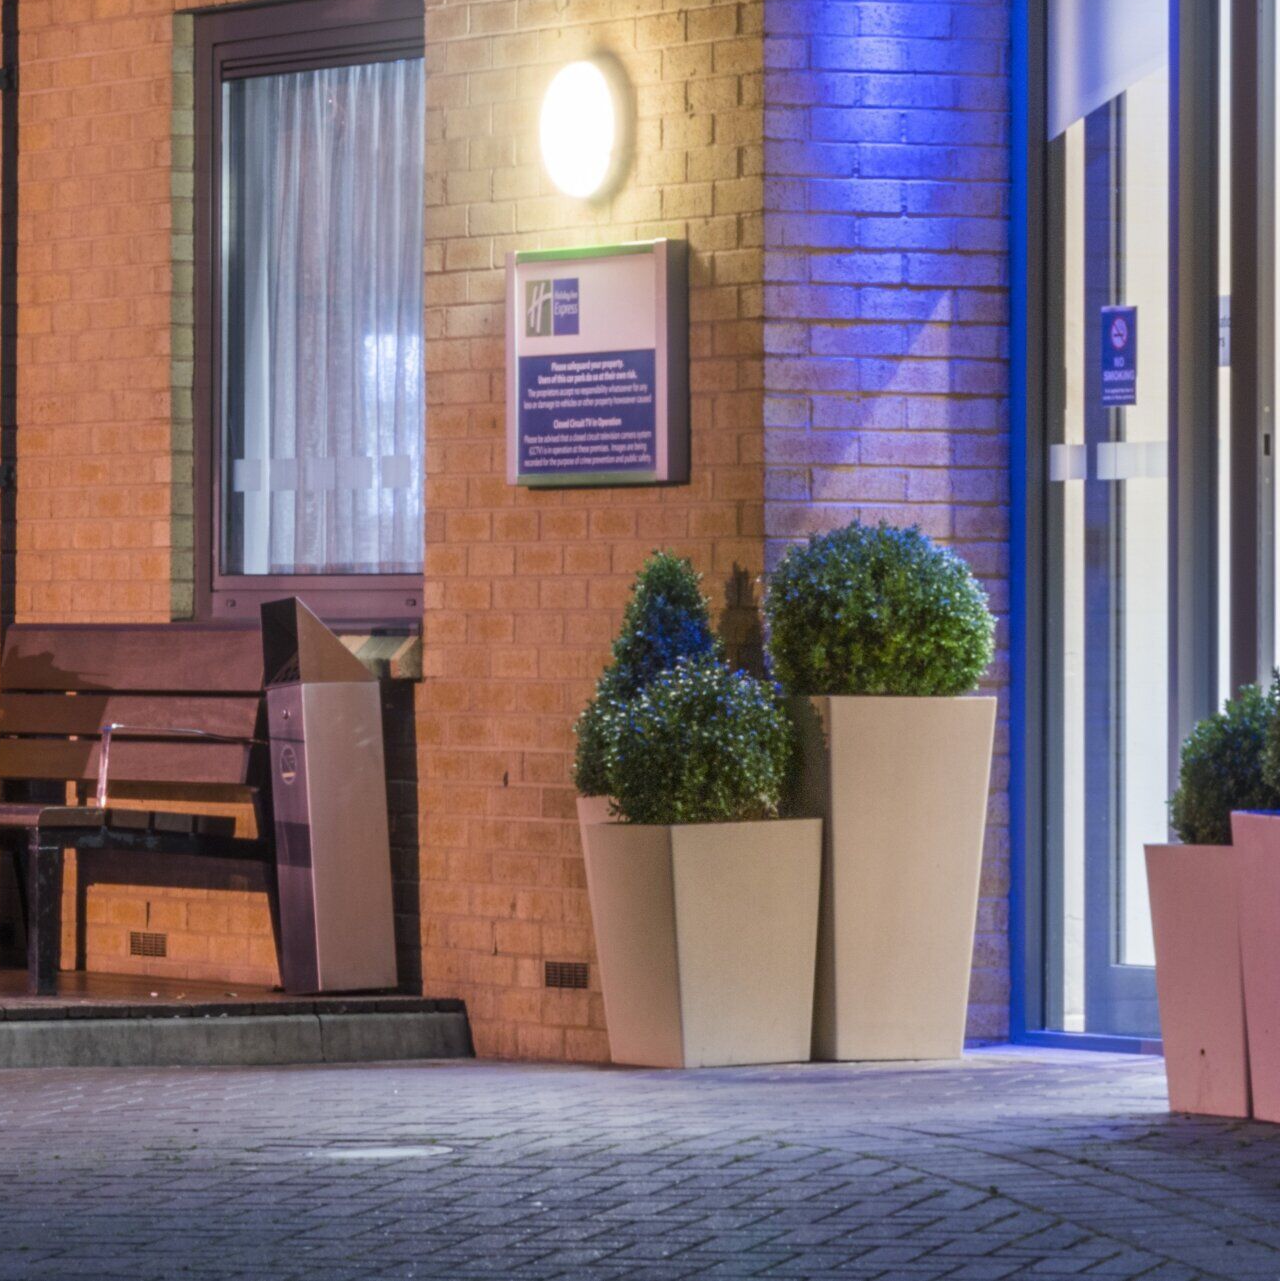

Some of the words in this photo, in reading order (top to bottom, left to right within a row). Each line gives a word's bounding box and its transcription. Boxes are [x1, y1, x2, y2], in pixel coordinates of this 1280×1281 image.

[554, 290, 571, 302] Holiday
[554, 302, 578, 318] Express
[551, 362, 566, 372] Please
[566, 360, 590, 372] safeguard
[590, 362, 601, 371] your
[1114, 356, 1125, 368] NO
[538, 375, 551, 385] Users
[557, 373, 566, 384] this
[574, 373, 586, 384] park
[604, 371, 616, 381] their
[616, 372, 626, 380] own
[1103, 370, 1135, 381] SMOKING
[528, 388, 536, 398] The
[560, 388, 574, 397] accept
[581, 385, 608, 396] responsibility
[538, 400, 555, 411] damage
[560, 398, 577, 408] vehicles
[583, 397, 594, 407] other
[594, 398, 613, 408] property
[553, 418, 569, 430] Closed
[570, 418, 585, 429] Circuit
[585, 417, 592, 427] TV
[598, 416, 622, 428] Operation
[524, 434, 538, 444] Please
[543, 434, 560, 443] advised
[573, 433, 586, 442] closed
[586, 432, 599, 441] circuit
[599, 431, 620, 441] television
[620, 432, 636, 440] camera
[636, 431, 652, 440] system
[553, 446, 573, 456] operation
[611, 444, 626, 454] Images
[634, 442, 647, 453] being
[524, 458, 543, 468] recorded
[557, 459, 575, 469] purpose
[592, 456, 615, 466] prevention
[624, 453, 638, 464] public
